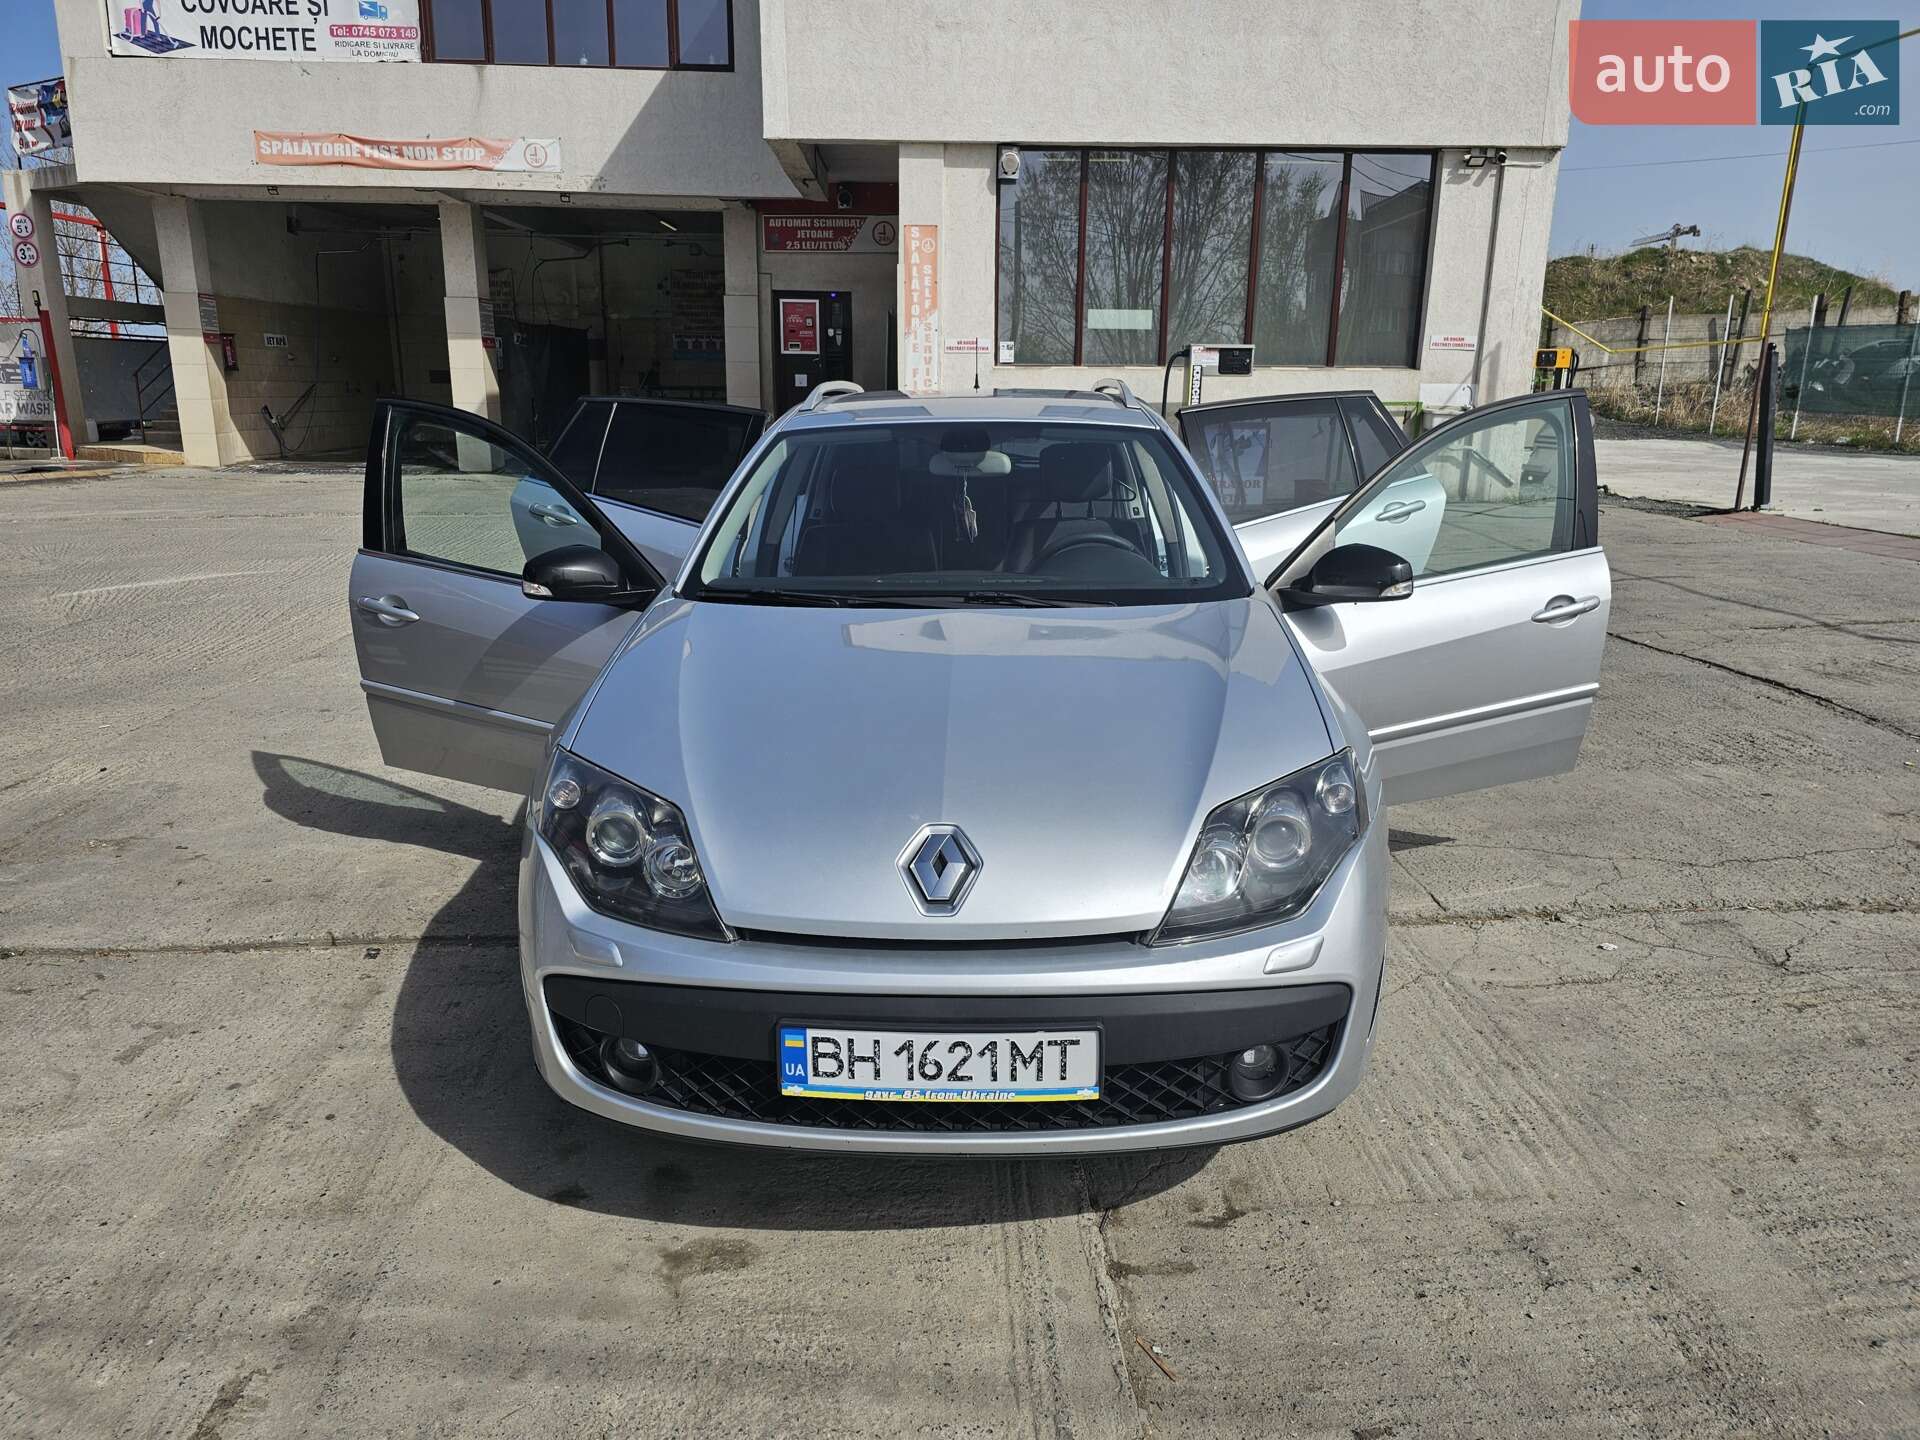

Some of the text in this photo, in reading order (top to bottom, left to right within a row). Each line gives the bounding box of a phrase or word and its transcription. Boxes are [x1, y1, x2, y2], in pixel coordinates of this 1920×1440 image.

[199, 25, 317, 51] MOCHETE
[331, 26, 416, 38] Tel: 0745 073 148
[351, 49, 362, 57] LA
[402, 145, 438, 160] NON
[441, 146, 486, 161] STOP
[17, 225, 23, 233] 5
[769, 219, 860, 228] AUTOMAT SCHIMBAT
[797, 230, 834, 238] JETOANE
[19, 248, 27, 260] 3
[17, 402, 50, 415] WASH
[812, 1036, 1080, 1082] BH 1621 MT
[785, 1063, 805, 1077] UA
[961, 1089, 1016, 1100] Ukraine
